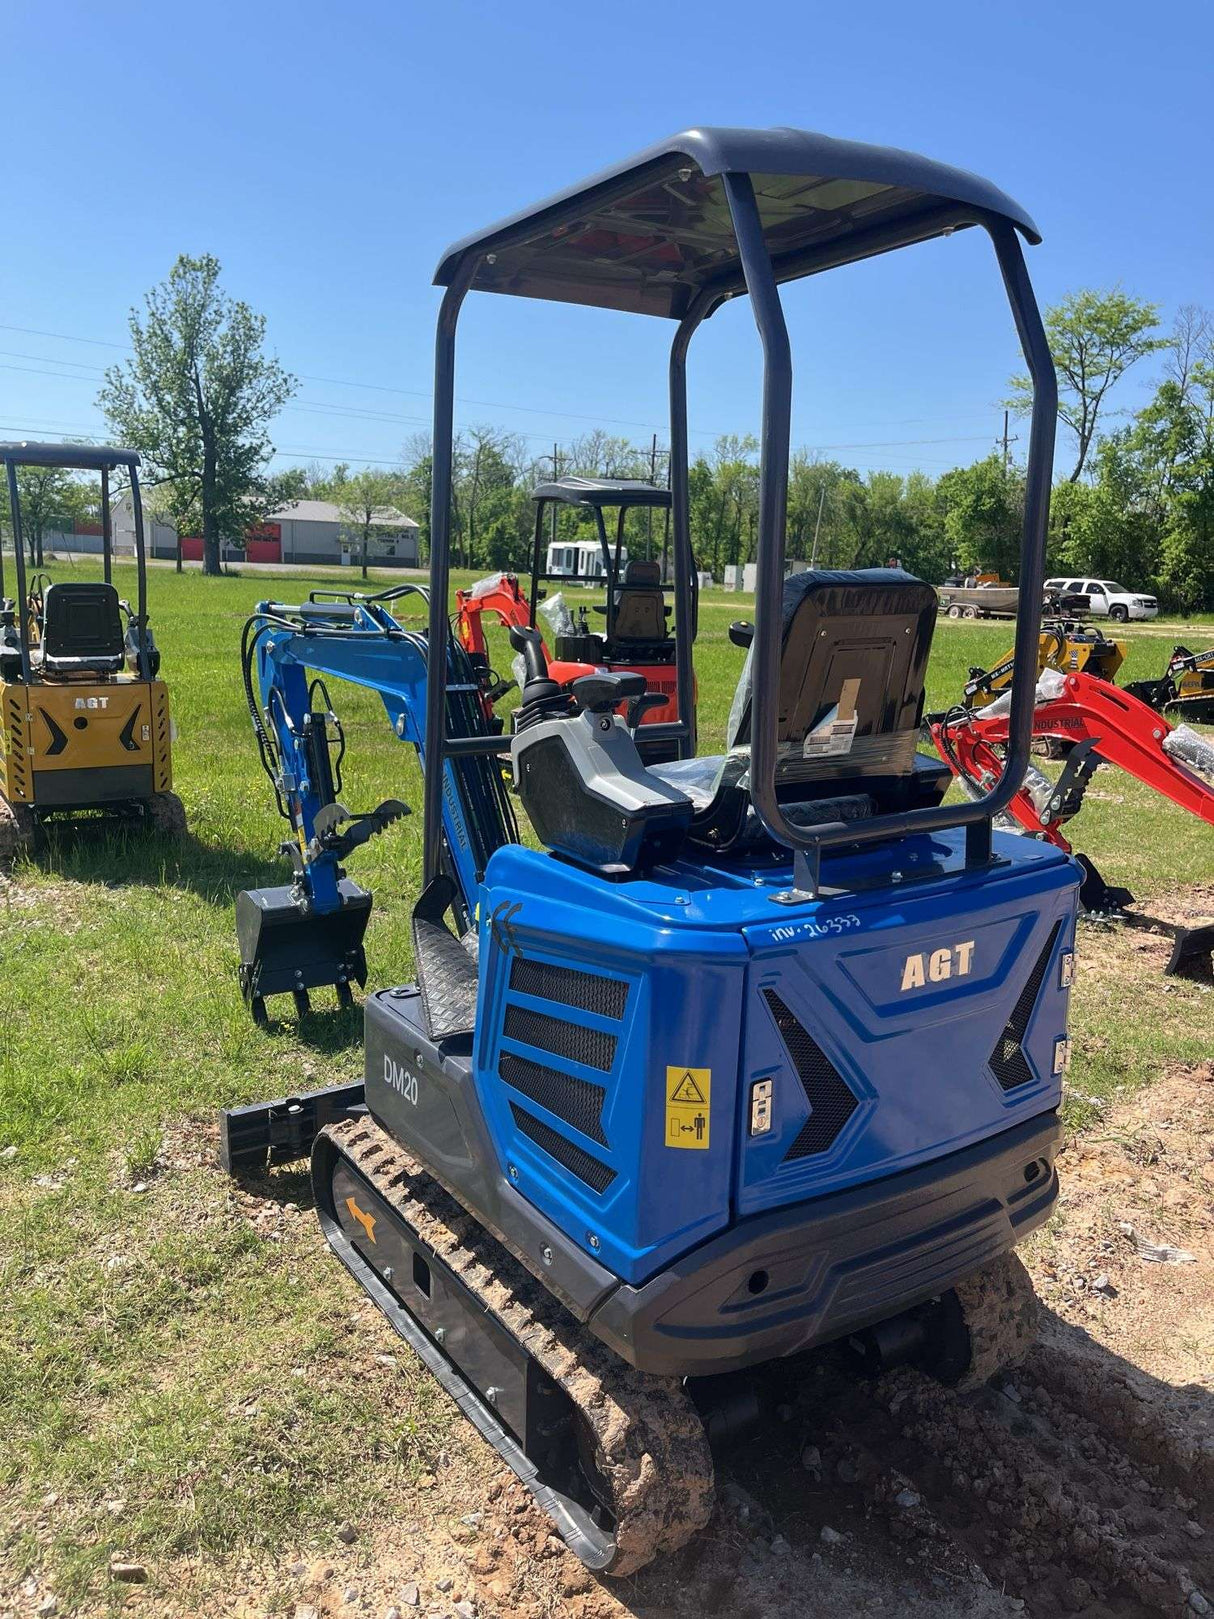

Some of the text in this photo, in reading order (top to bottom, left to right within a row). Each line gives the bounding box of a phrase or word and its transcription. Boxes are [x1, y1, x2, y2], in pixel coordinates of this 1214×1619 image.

[74, 697, 109, 709] AGT
[1034, 717, 1086, 729] NDUSTRIAL
[901, 940, 975, 991] AGT
[384, 1054, 418, 1106] DM20
